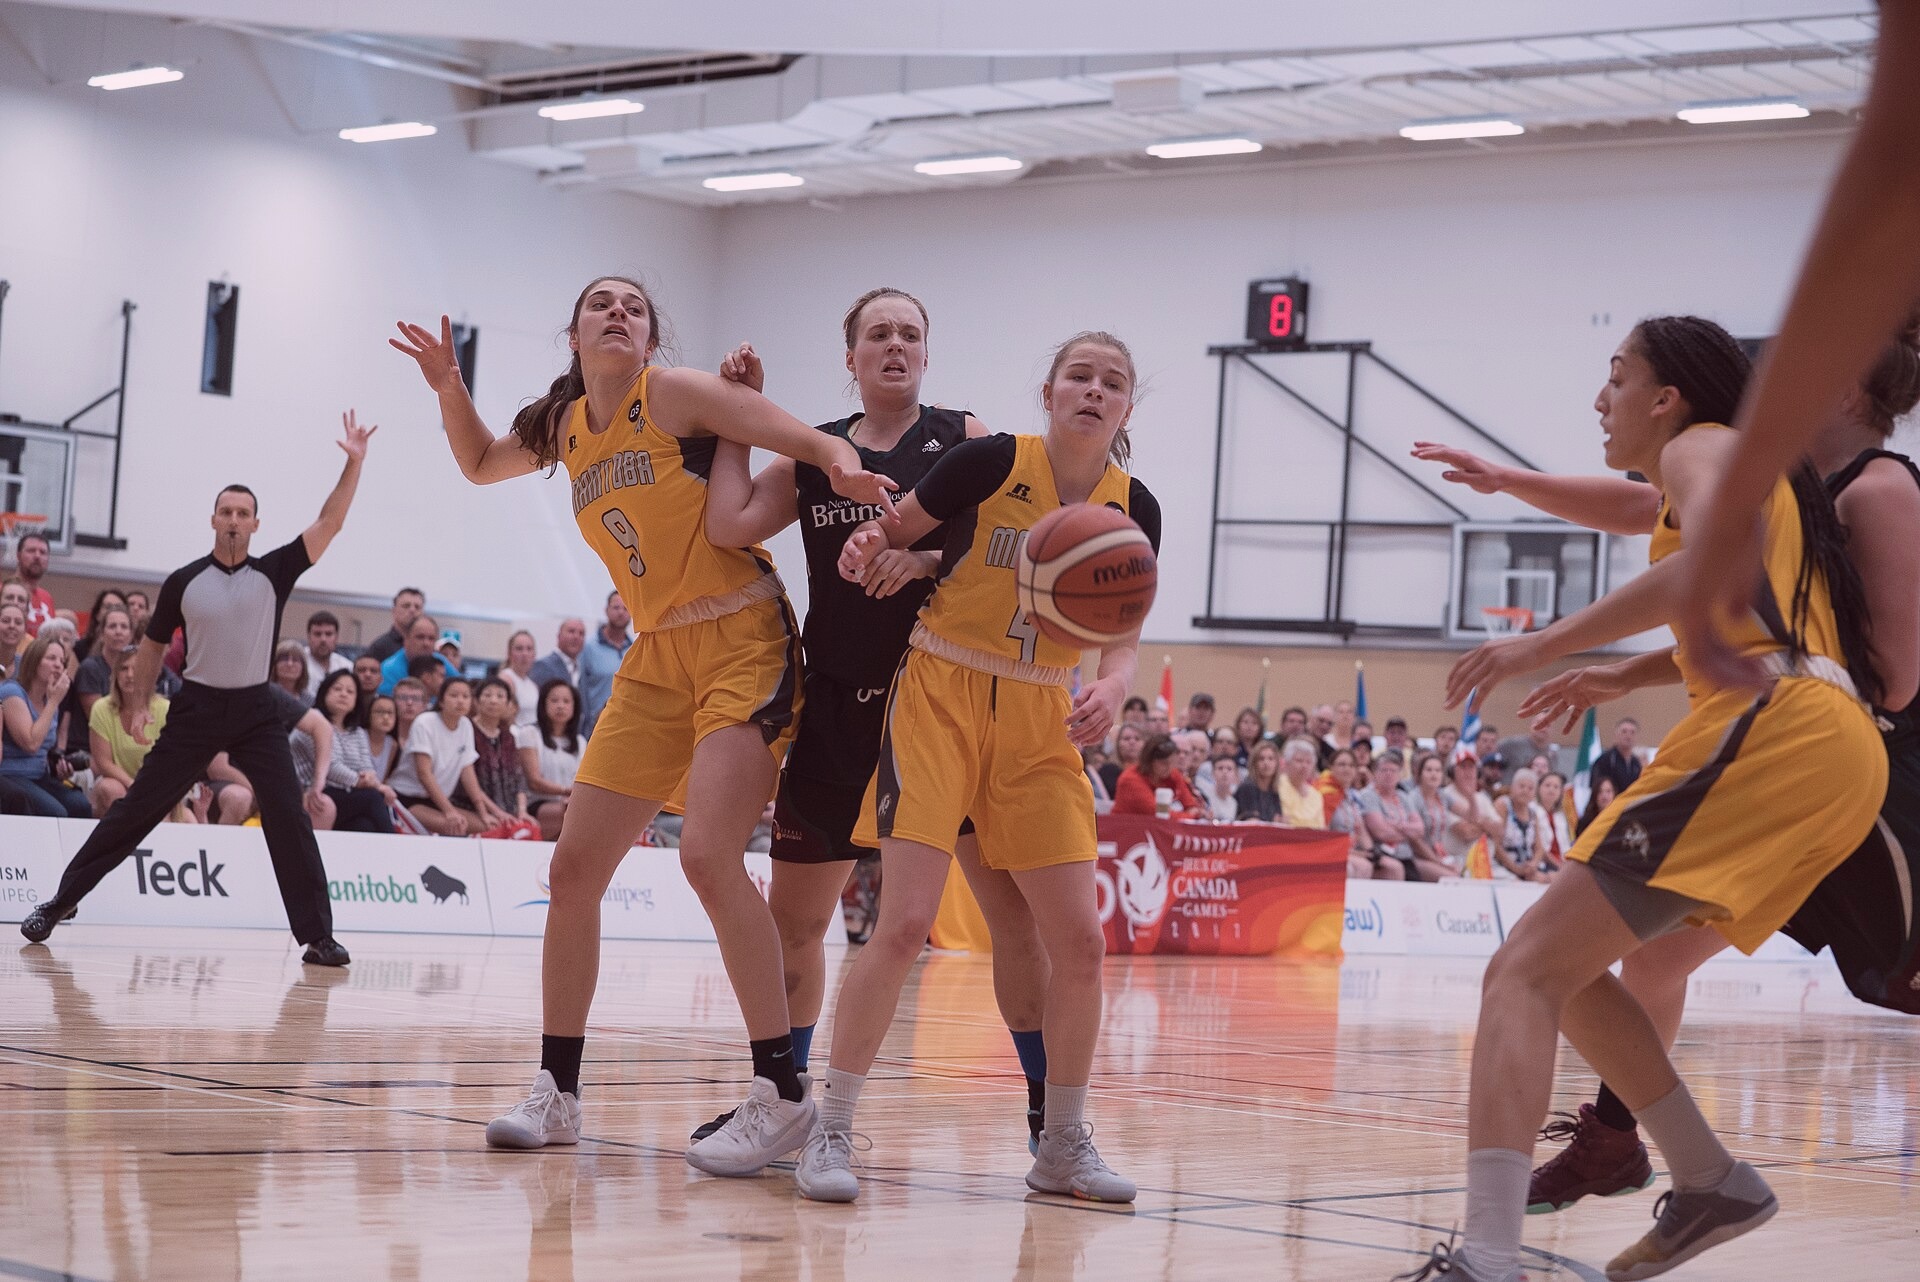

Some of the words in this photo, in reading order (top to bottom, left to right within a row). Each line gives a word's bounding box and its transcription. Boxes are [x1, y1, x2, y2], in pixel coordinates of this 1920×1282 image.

[1269, 294, 1293, 337] 8
[828, 499, 853, 510] New
[1005, 492, 1032, 505] RUSSELL
[602, 507, 646, 577] 9
[1006, 605, 1039, 664] 4
[129, 849, 229, 897] Teck
[1173, 876, 1239, 900] CANADA
[328, 874, 418, 904] anitoba
[1182, 902, 1228, 917] GAMES
[1436, 904, 1492, 935] Canada
